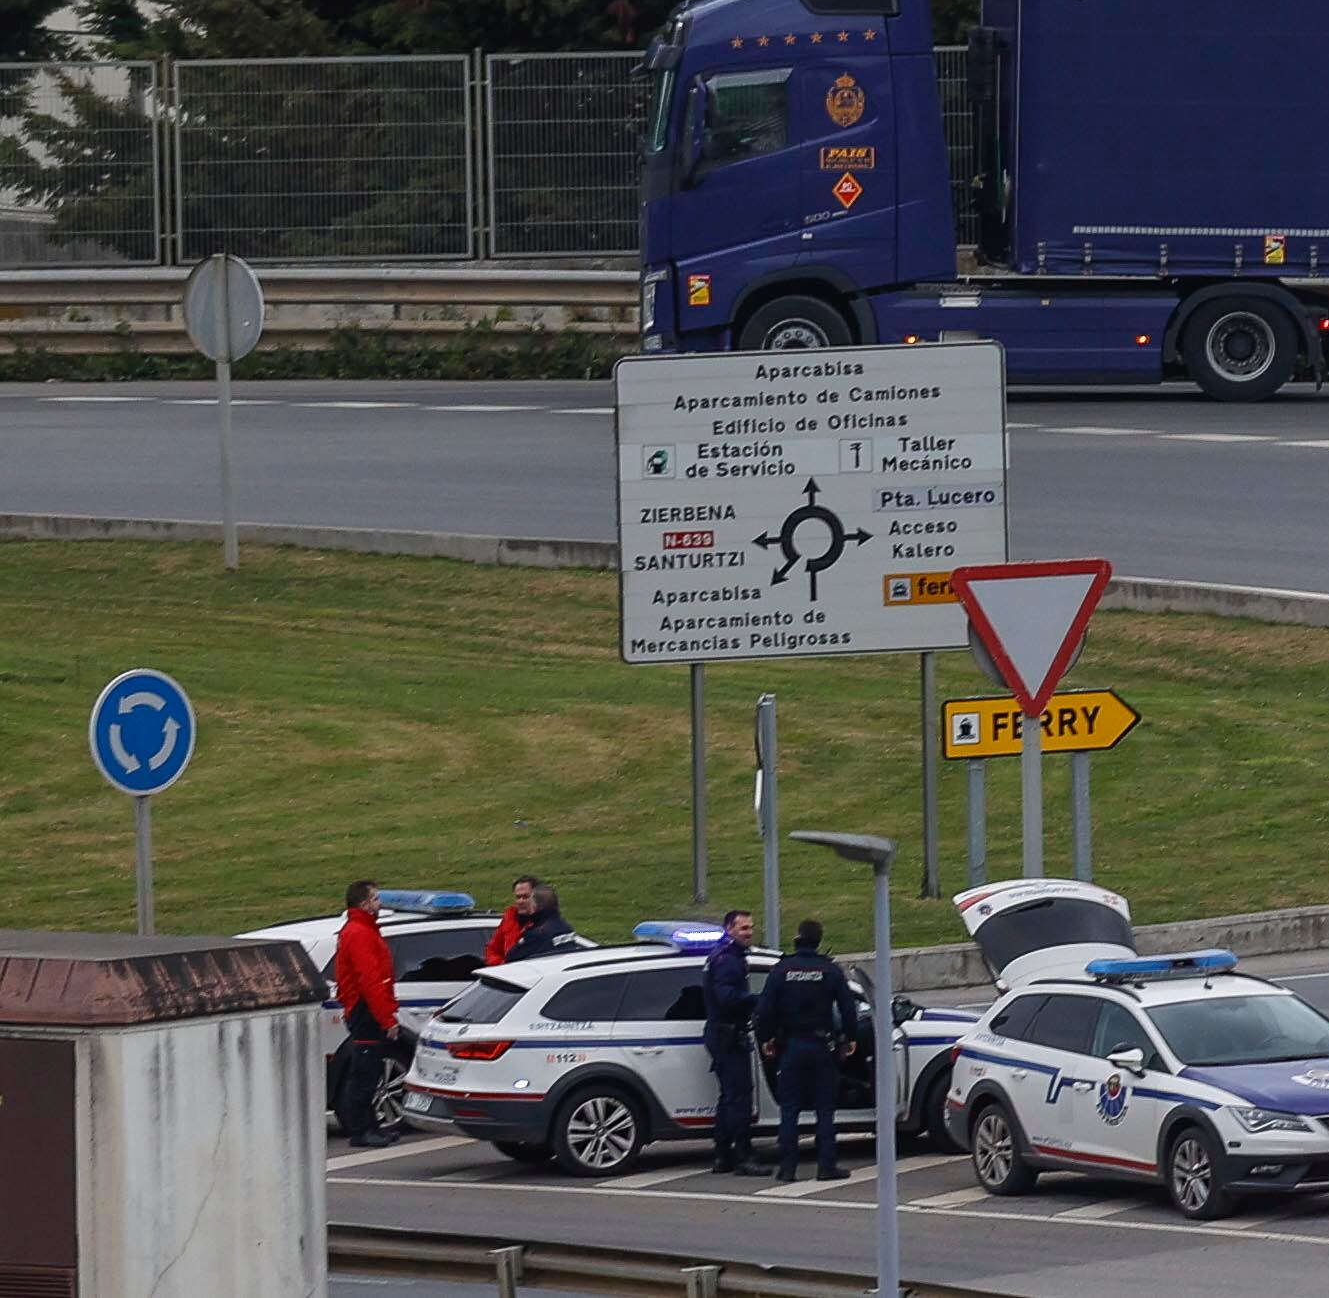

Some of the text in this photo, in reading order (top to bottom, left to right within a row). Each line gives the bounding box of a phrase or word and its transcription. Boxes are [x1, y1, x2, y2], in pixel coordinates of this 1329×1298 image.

[755, 361, 864, 382] Aparcabisa
[673, 385, 941, 413] Aparcamiento de Camiones
[712, 413, 908, 436] Edificio de Oficinas
[697, 440, 783, 459] Estación
[898, 436, 956, 453] Taller
[685, 459, 796, 479] de Servicio
[882, 454, 972, 473] Mecánico
[881, 489, 995, 508] Pta. Lucero
[640, 506, 736, 524] ZIERBENA
[888, 520, 958, 536] Acceso
[892, 543, 955, 559] Kalero
[634, 551, 745, 572] SANTURTZI
[652, 585, 762, 607] Aparcabisa
[659, 609, 826, 633] Aparcamiento de
[749, 632, 852, 650] Peligrosas
